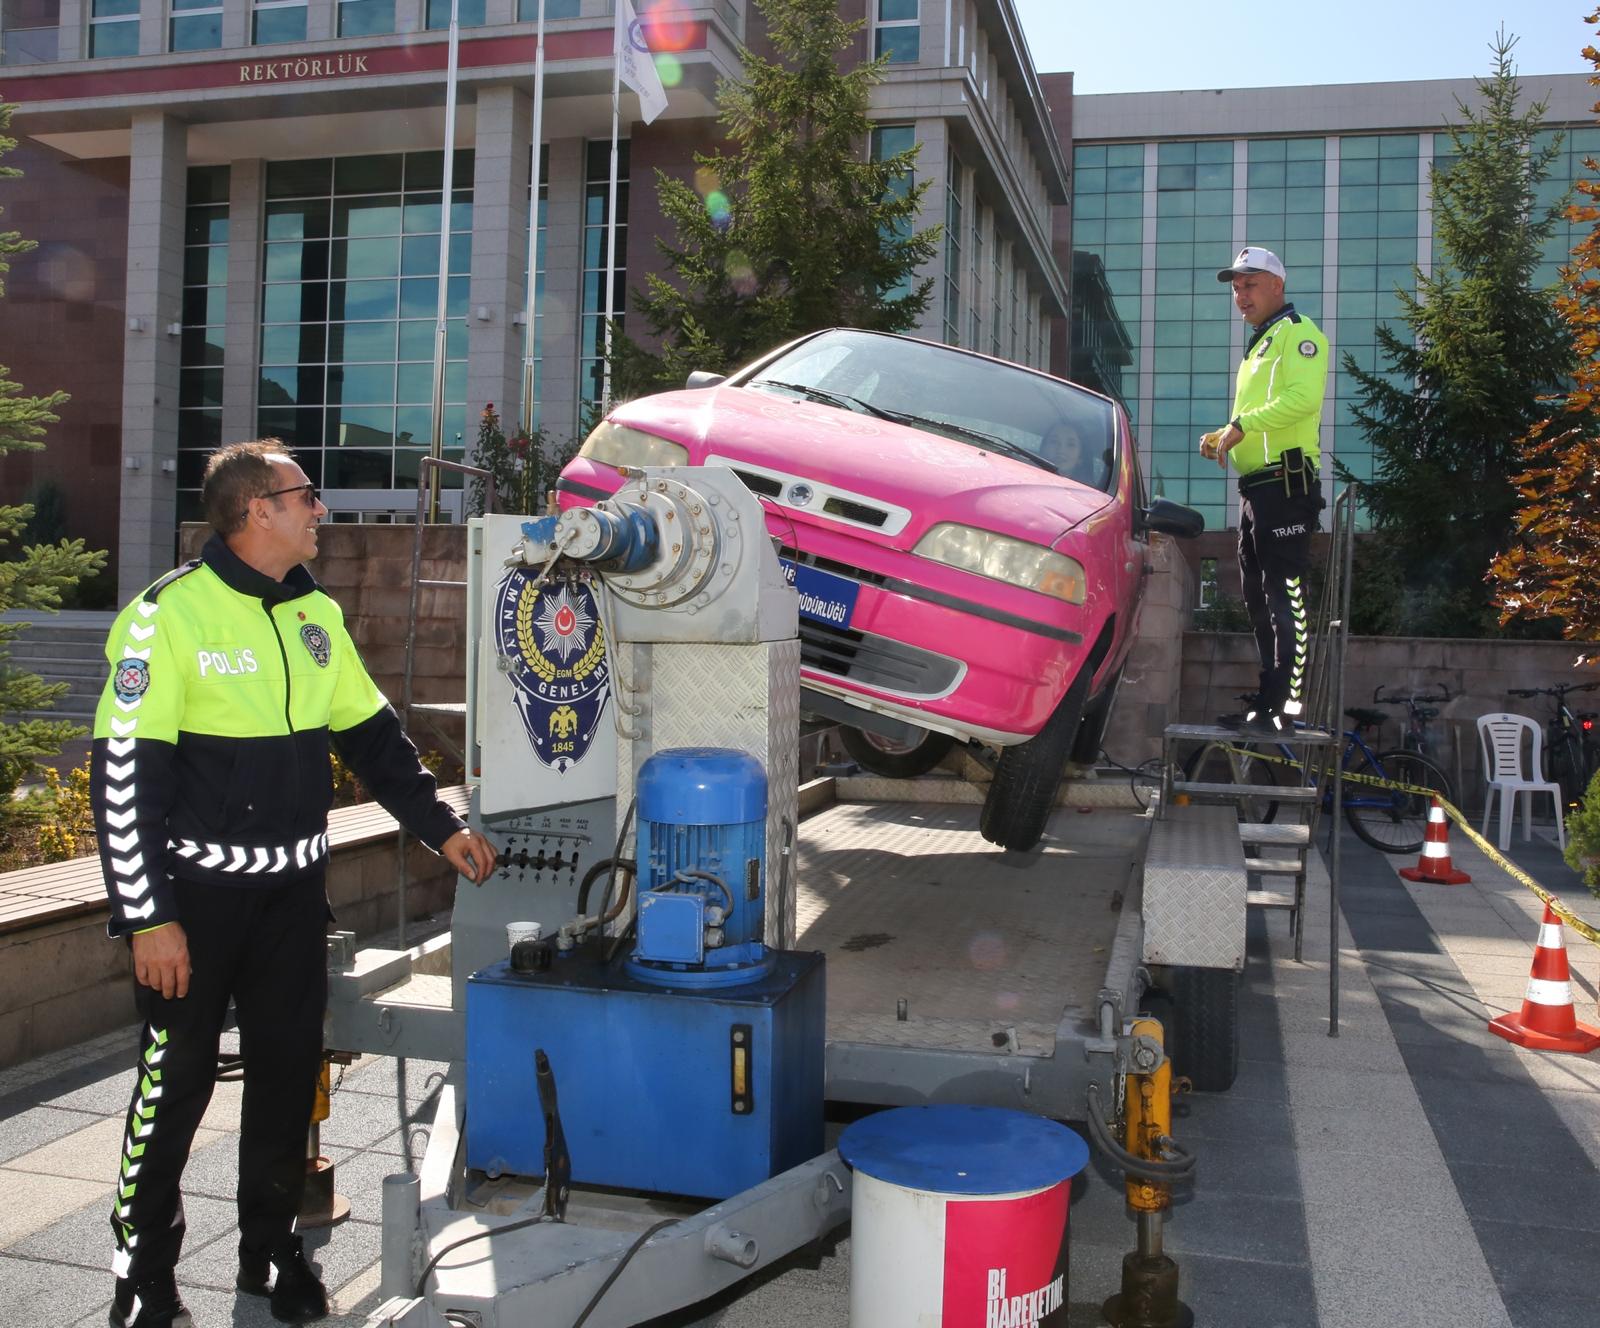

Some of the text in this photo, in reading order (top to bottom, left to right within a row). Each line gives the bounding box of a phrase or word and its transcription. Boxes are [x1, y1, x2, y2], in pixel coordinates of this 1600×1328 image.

[239, 53, 368, 82] REKTÖRLÜK
[799, 592, 847, 623] ÜDÜRLÜĞÜ
[556, 669, 572, 678] EGM
[538, 680, 589, 698] GENEL
[551, 741, 574, 753] 1845
